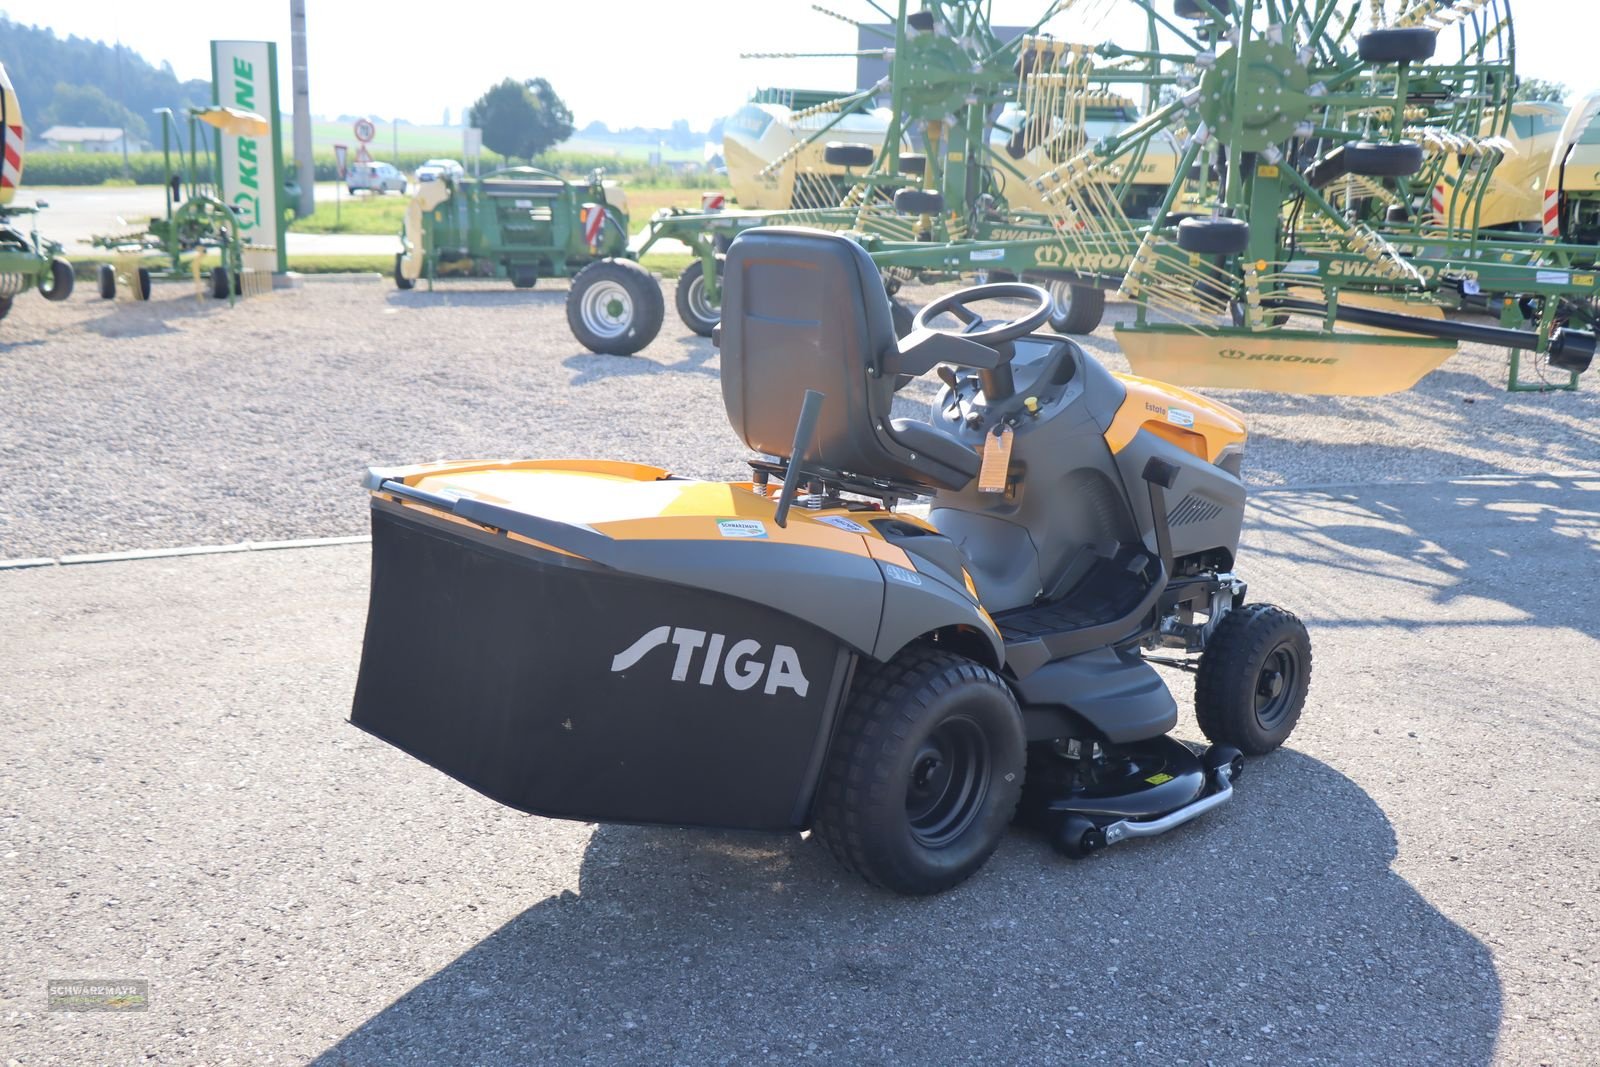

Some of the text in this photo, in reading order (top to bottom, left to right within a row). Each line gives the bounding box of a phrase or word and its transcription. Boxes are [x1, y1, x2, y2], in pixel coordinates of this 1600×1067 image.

[233, 56, 258, 190] KRNE
[1246, 353, 1339, 365] KRONE
[1145, 401, 1166, 416] Estate
[610, 625, 810, 698] STIGA
